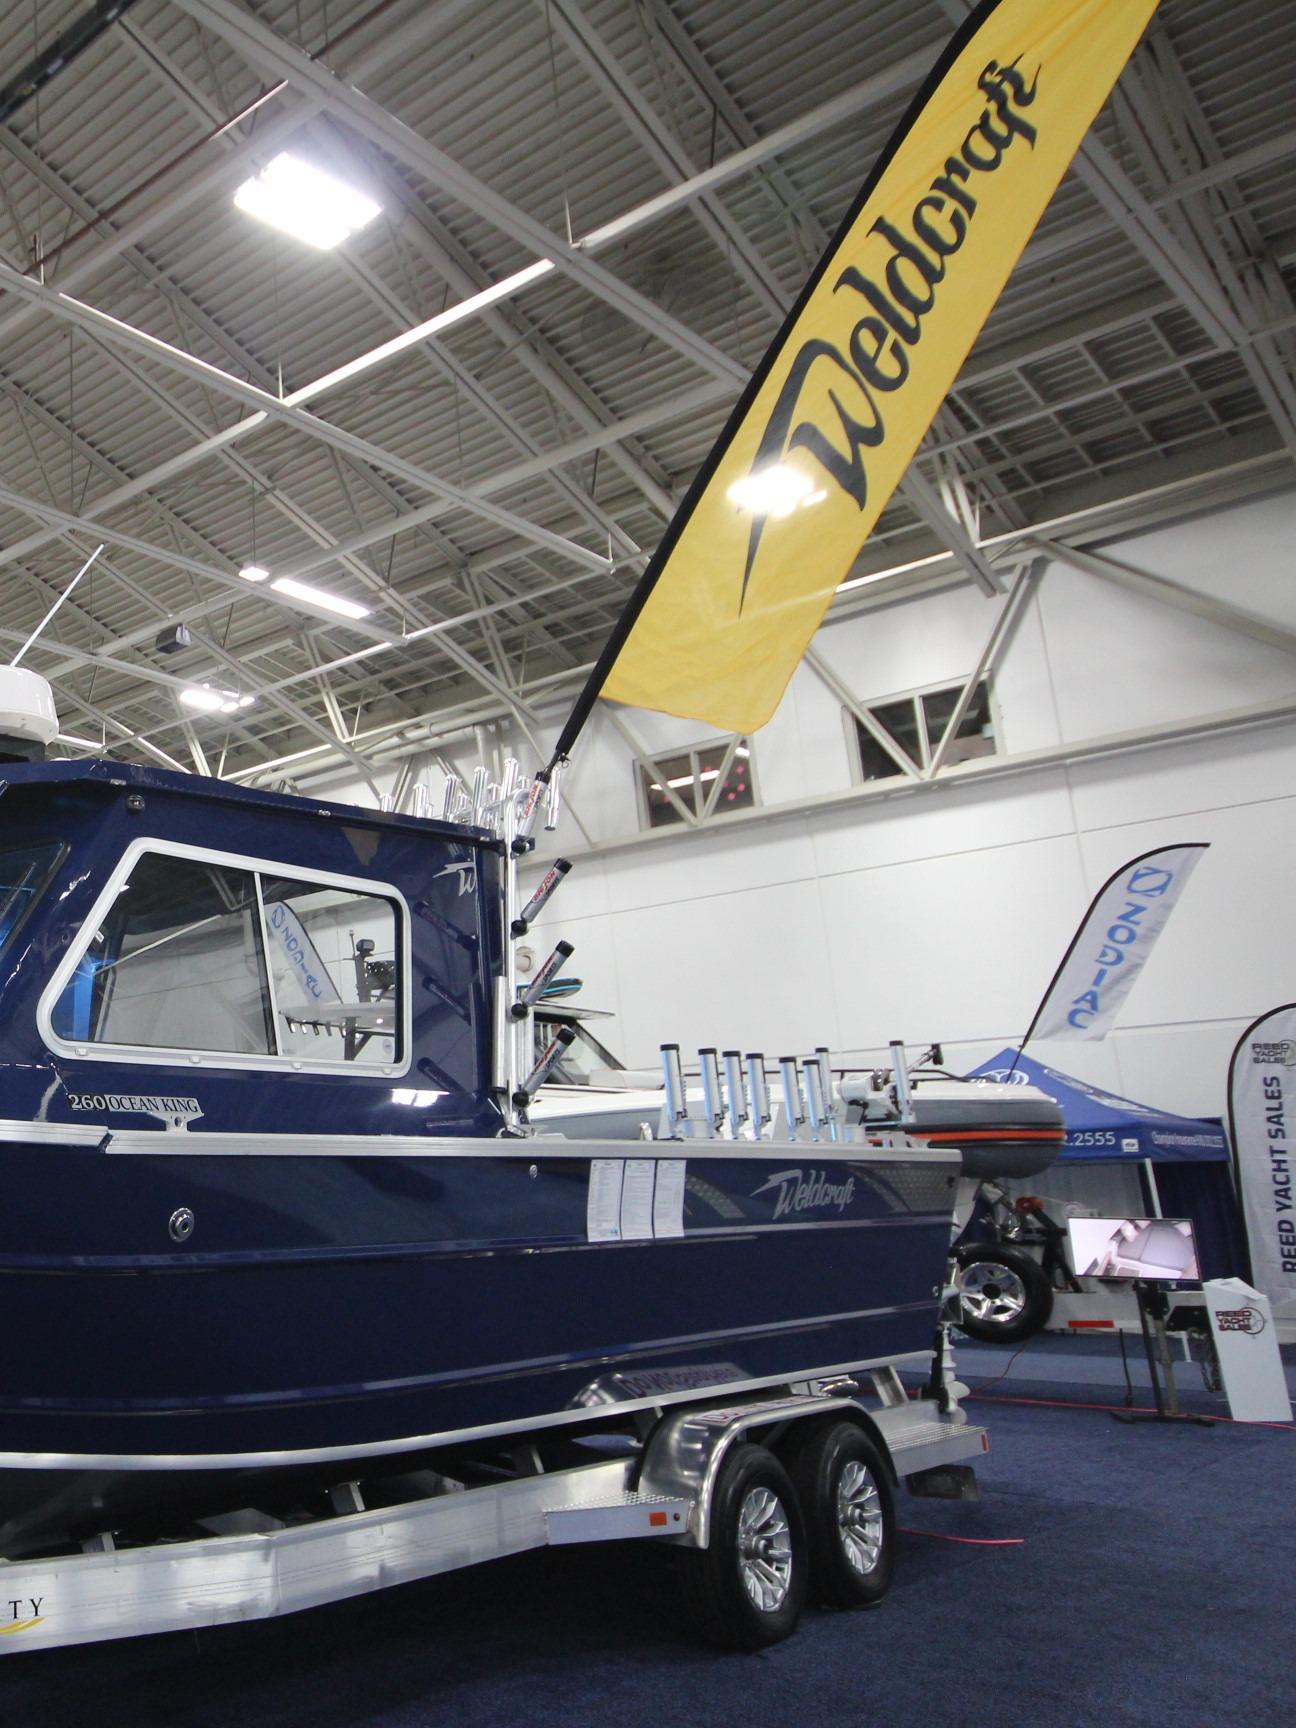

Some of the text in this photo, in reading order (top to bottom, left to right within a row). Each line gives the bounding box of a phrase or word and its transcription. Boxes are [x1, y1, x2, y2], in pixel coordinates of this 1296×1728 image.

[739, 52, 1041, 619] Weldcraft
[1067, 902, 1148, 1029] ZODIAC
[68, 1094, 198, 1113] 260 OCEAN KING
[1065, 1131, 1116, 1147] .2555
[749, 1169, 856, 1220] Weldcraft
[1264, 1076, 1296, 1273] REED YACHT SALES
